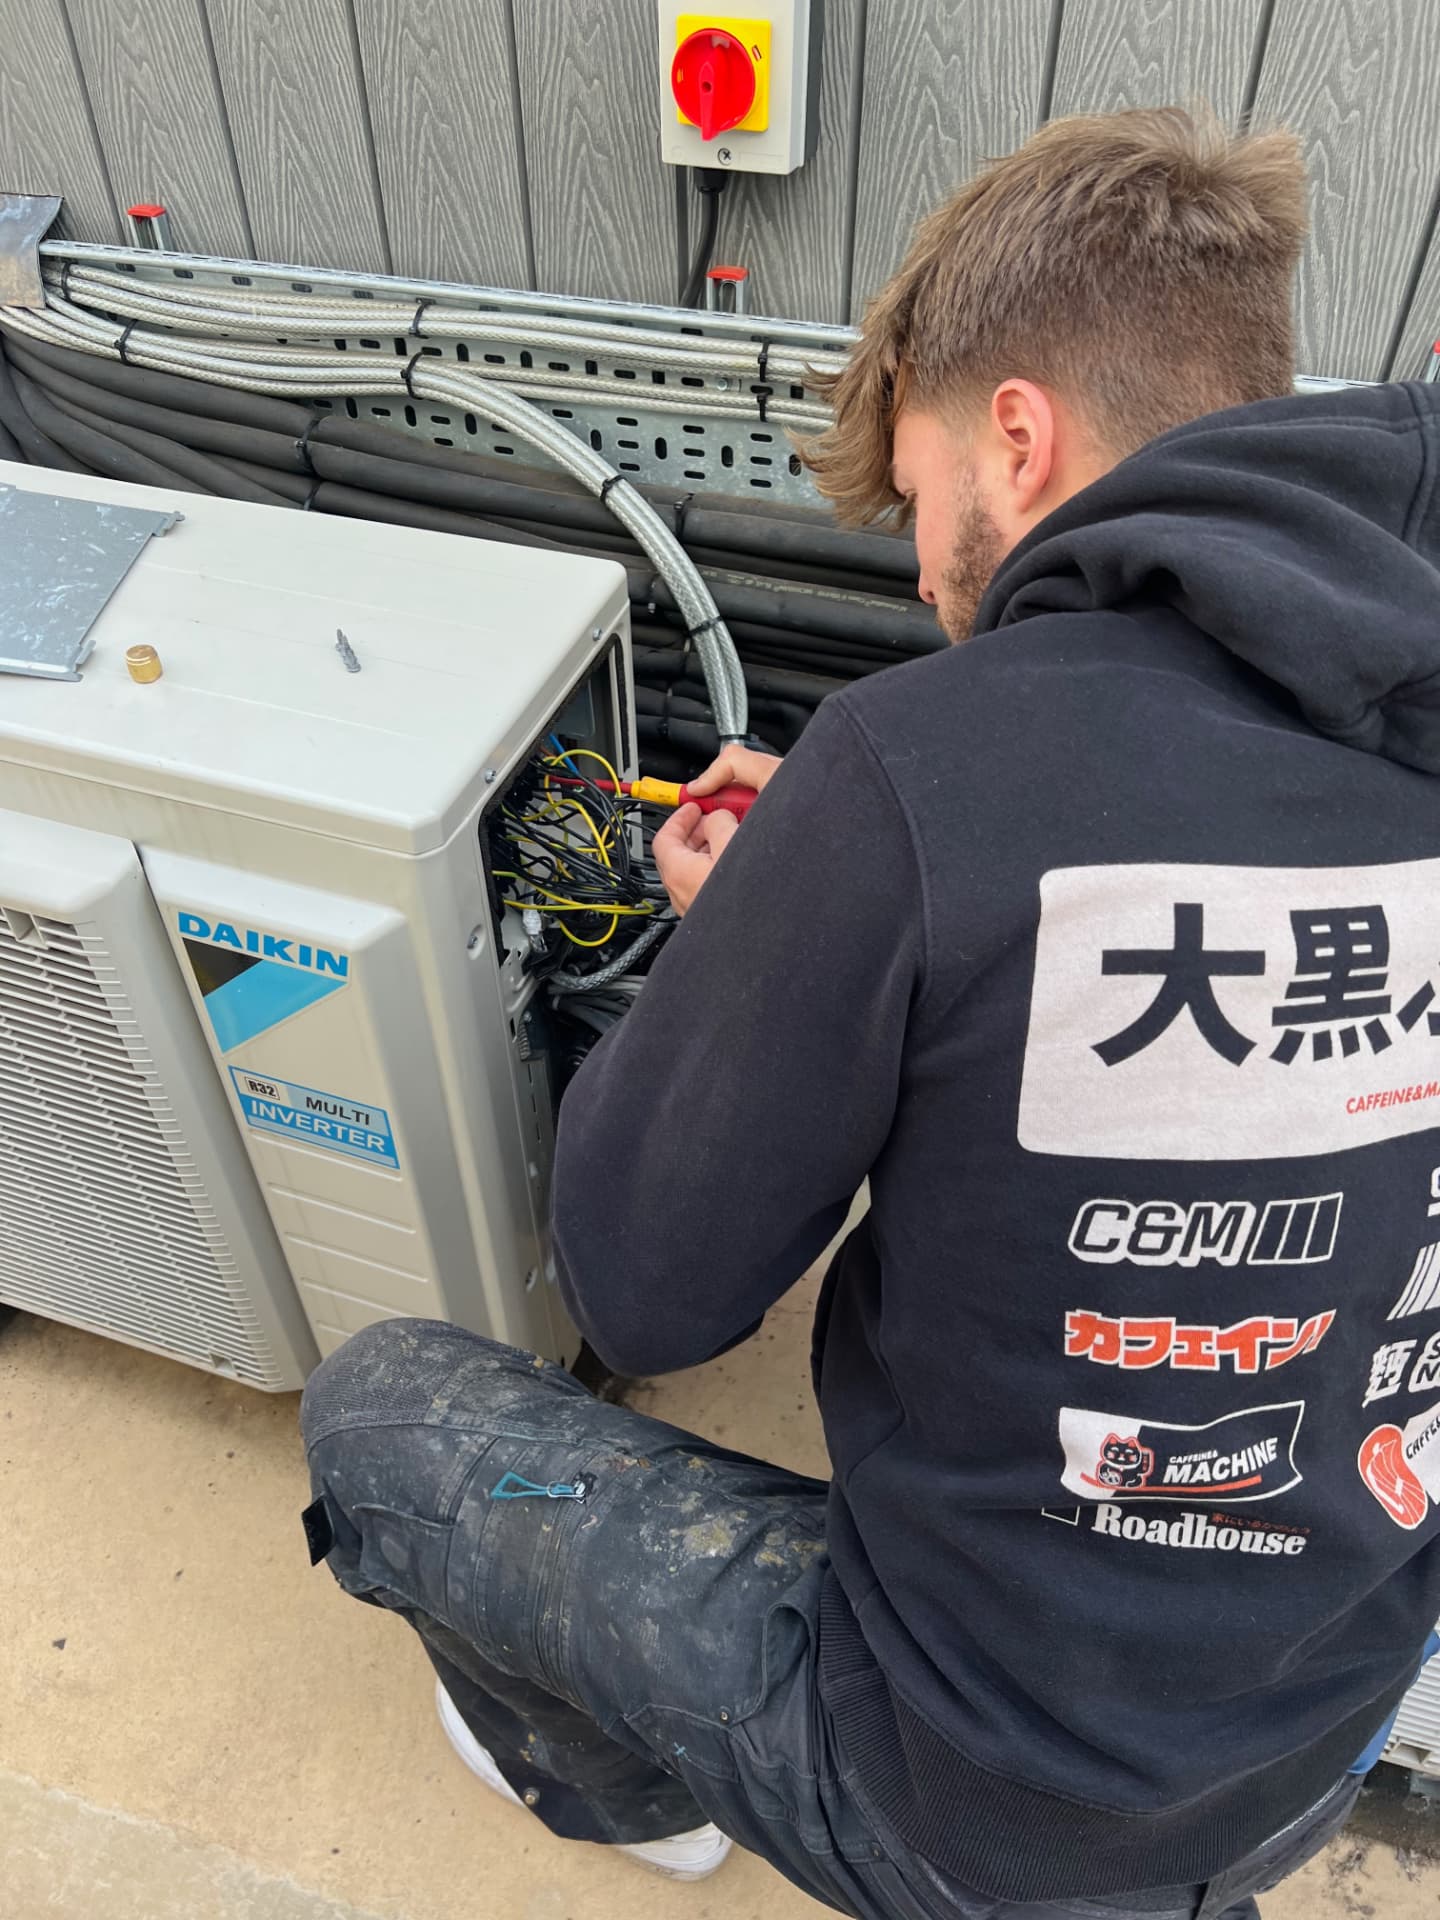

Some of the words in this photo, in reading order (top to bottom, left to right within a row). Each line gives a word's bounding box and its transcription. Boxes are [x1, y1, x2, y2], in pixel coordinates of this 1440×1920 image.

[178, 912, 349, 977] DAIKIN
[247, 1080, 277, 1097] R32
[306, 1096, 370, 1126] MULTI
[251, 1100, 385, 1152] INVERTER
[1064, 1308, 1336, 1374] カフェイン
[1163, 1437, 1278, 1483] MACHINE
[1091, 1504, 1307, 1555] Roadhouse
